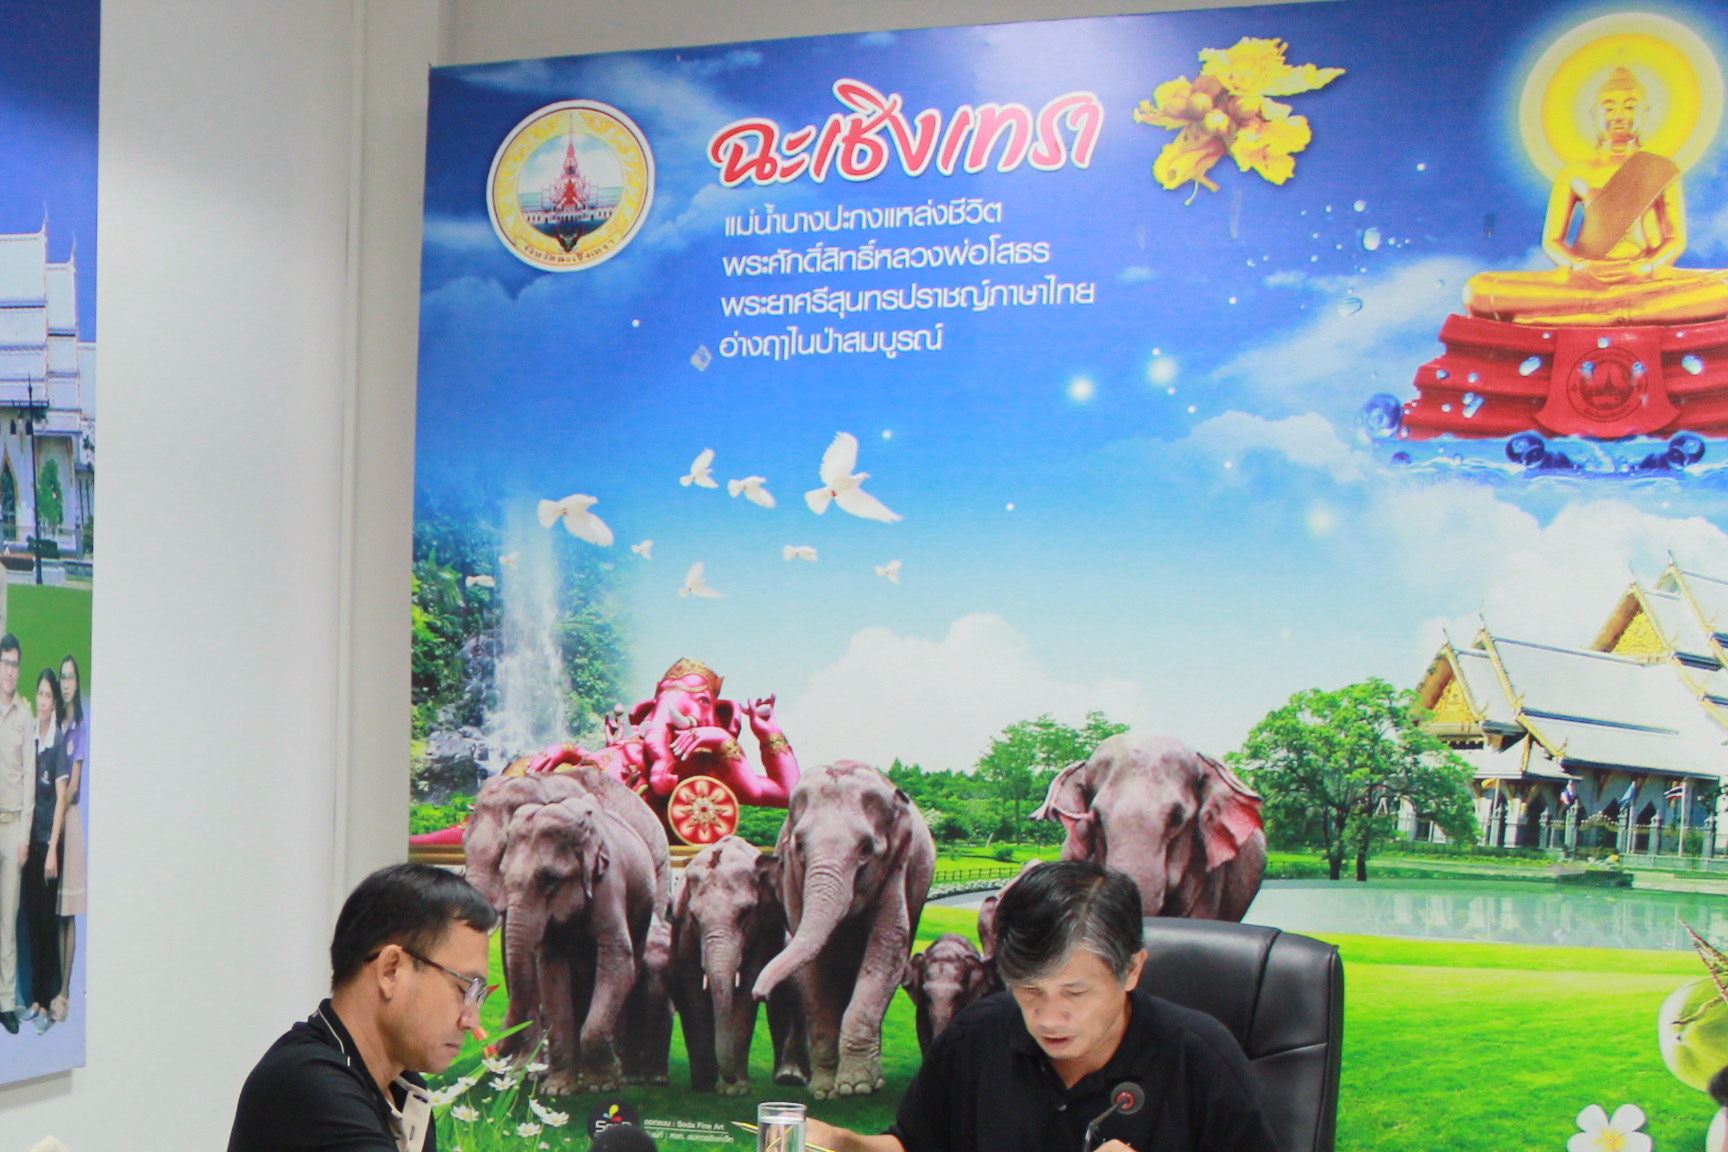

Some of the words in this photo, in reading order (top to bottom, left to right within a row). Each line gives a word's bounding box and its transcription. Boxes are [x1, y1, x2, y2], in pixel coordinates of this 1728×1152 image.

[708, 79, 1103, 186] ฉะเชิงเทรา
[725, 198, 1003, 236] แม่น้ำบางปะกงแหล่งชีวิต
[722, 234, 1051, 276] พระศักดิ์สิทธิ์หลวงพ่อโสธร
[721, 275, 1095, 319] พระยาศรีสุนทรปราชญ์ภาษาไทย
